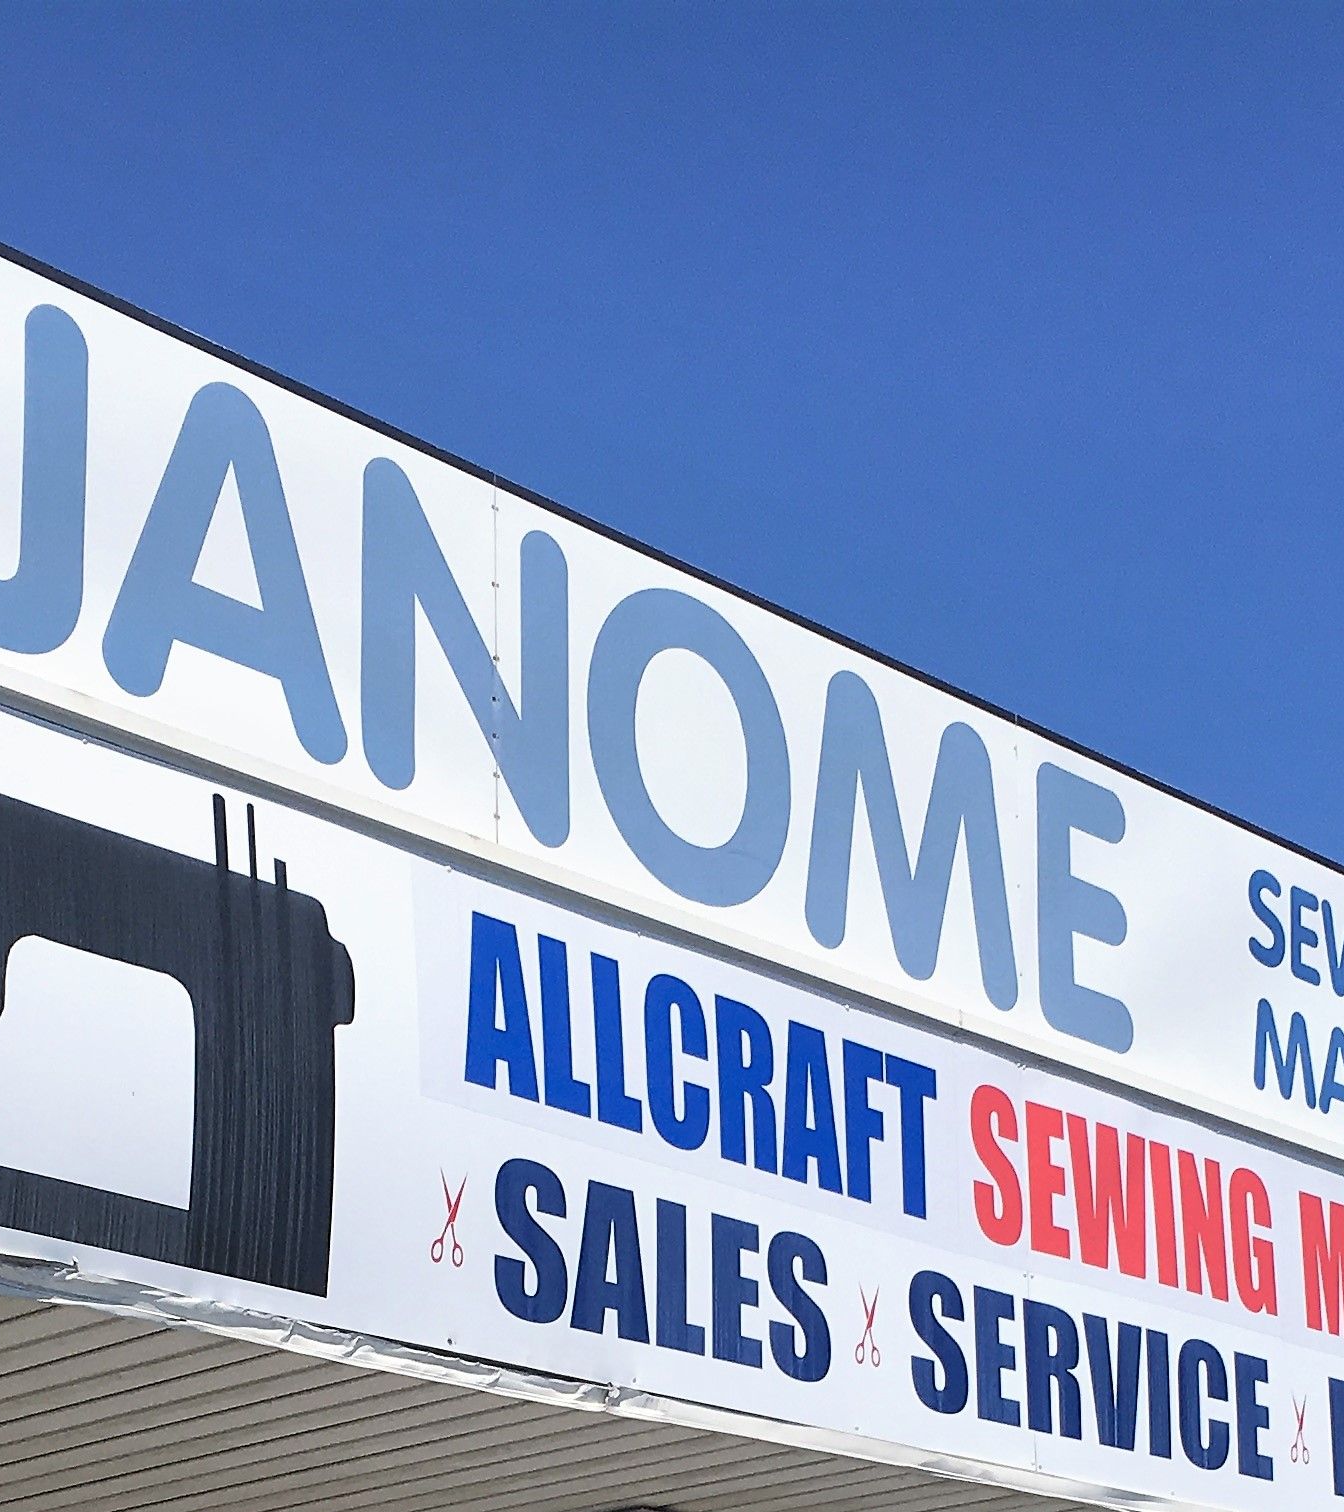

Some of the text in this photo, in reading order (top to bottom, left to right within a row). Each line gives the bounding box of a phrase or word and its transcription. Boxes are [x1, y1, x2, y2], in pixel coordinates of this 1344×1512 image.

[464, 910, 937, 1219] ALLCRAFT
[969, 1081, 1279, 1317] SEWING
[493, 1158, 831, 1383] SALES
[909, 1267, 1274, 1479] SERVICE
